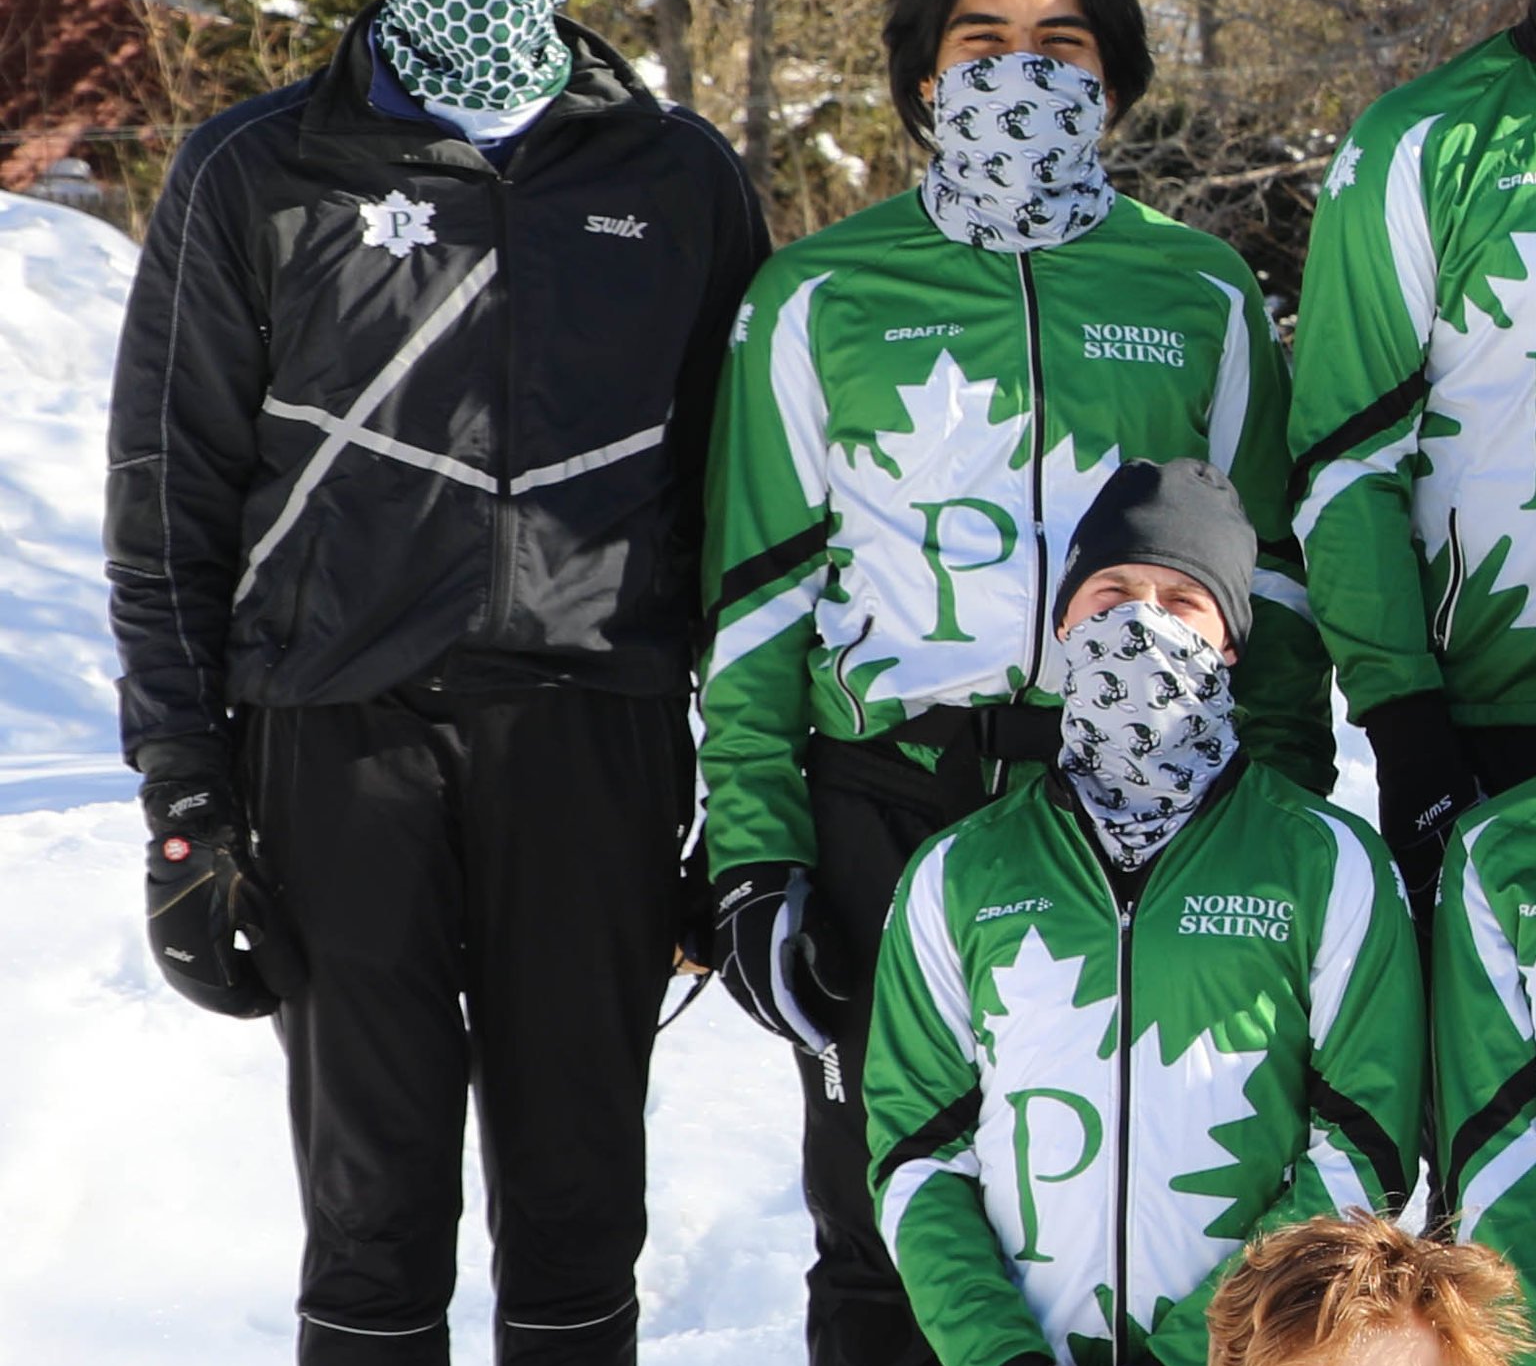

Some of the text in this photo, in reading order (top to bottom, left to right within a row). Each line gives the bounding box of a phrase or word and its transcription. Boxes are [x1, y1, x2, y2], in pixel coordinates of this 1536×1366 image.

[390, 211, 411, 238] P
[584, 215, 647, 238] swix
[885, 323, 948, 342] CRAFT
[1083, 323, 1185, 349] NORDIC
[1083, 341, 1185, 368] SKIING
[910, 497, 1019, 643] P
[974, 900, 1037, 923] CRAFT
[1183, 895, 1294, 923] NORDIC
[1178, 914, 1290, 942] SKIING
[1005, 1087, 1104, 1263] P
